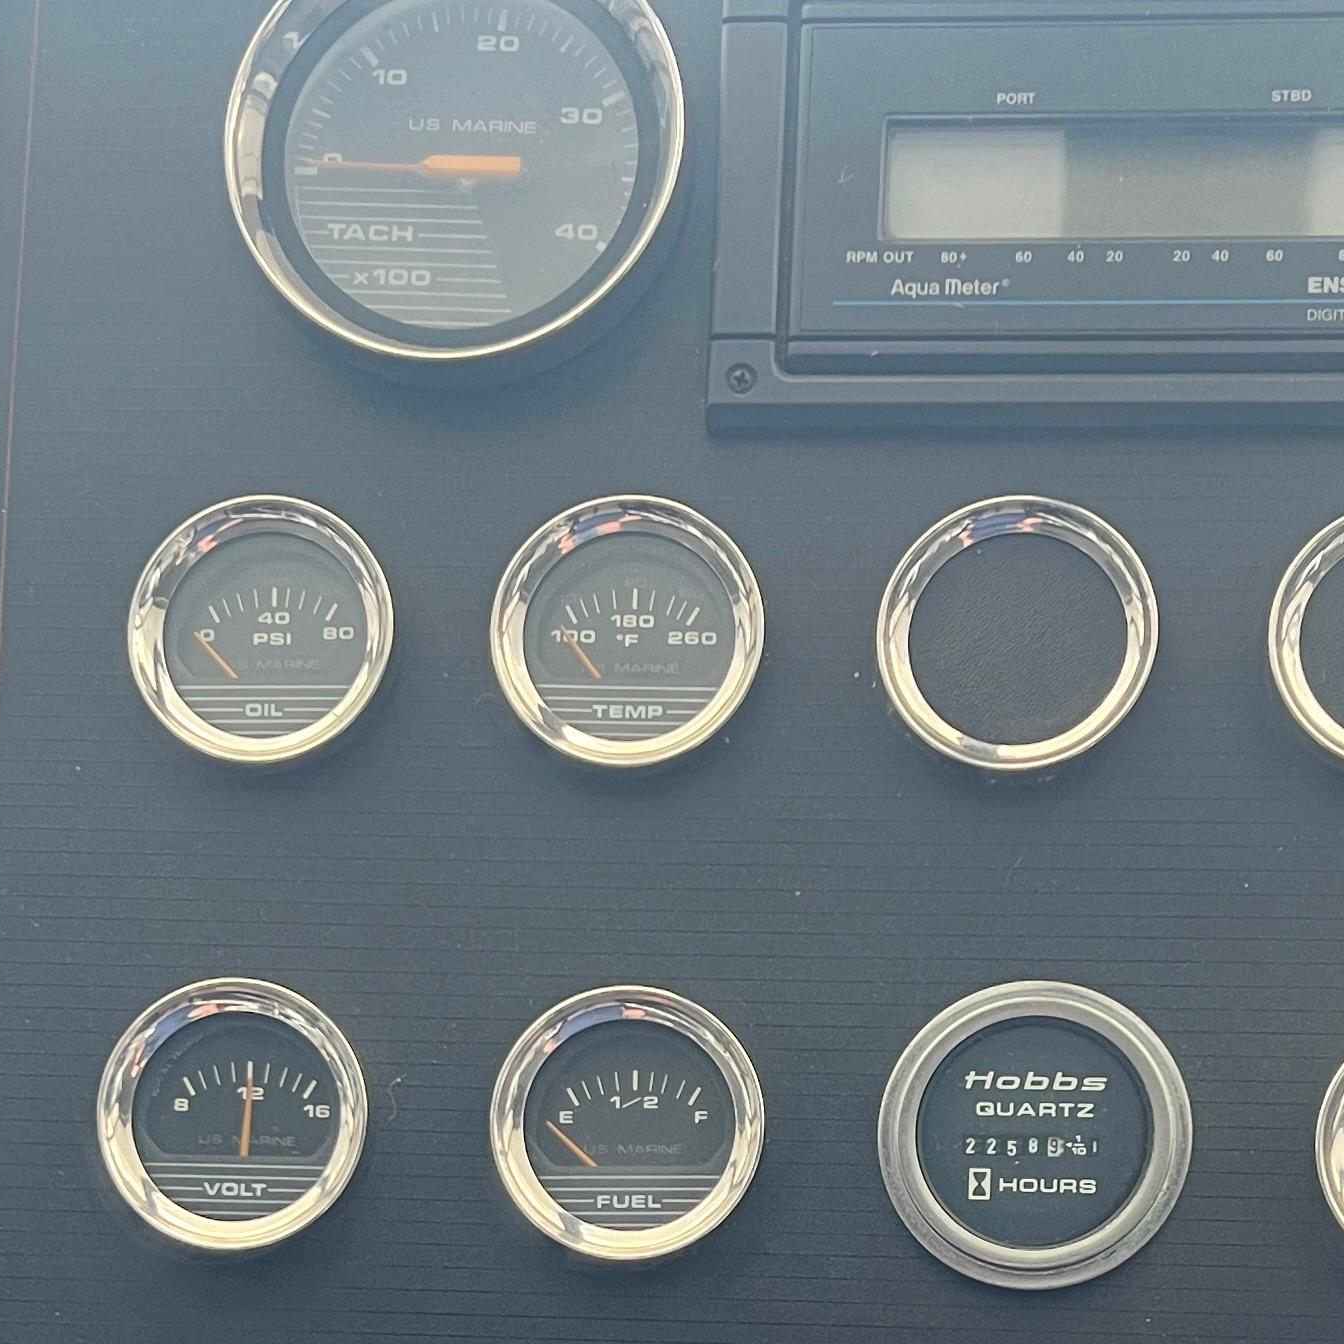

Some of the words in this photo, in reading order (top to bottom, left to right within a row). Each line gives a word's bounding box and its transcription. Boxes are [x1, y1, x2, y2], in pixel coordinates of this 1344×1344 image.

[477, 36, 520, 52] 20
[372, 69, 408, 85] 10
[997, 92, 1036, 105] PORT
[1271, 89, 1312, 102] STBD
[560, 108, 603, 125] 30
[409, 119, 440, 132] US
[453, 119, 537, 135] MARINE
[327, 223, 414, 243] TACH
[555, 224, 598, 241] 40
[846, 251, 879, 264] RPM
[883, 250, 914, 263] OUT
[1015, 250, 1032, 264] 60
[1067, 250, 1085, 263] 40
[1106, 250, 1123, 263] 20
[1173, 250, 1191, 263] 20
[1212, 250, 1229, 263] 40
[1266, 249, 1284, 262] 60
[890, 278, 940, 298] Aqua
[258, 612, 291, 625] 40
[610, 614, 656, 628] 180
[199, 628, 216, 642] 0
[253, 632, 292, 646] PSI
[322, 626, 355, 640] 80
[551, 629, 596, 644] 100
[667, 631, 718, 645] 260
[614, 662, 680, 675] MARINE
[244, 703, 283, 717] OIL
[592, 704, 663, 719] TEMP
[964, 1070, 1108, 1091] Hobbs
[236, 1086, 265, 1101] 12
[173, 1098, 190, 1112] 8
[609, 1095, 659, 1109] 1/2
[975, 1101, 1095, 1118] QUARTZ
[303, 1104, 331, 1119] 16
[558, 1110, 574, 1124] E
[694, 1110, 709, 1124] F
[617, 1143, 684, 1155] MARINE
[203, 1182, 267, 1197] VOLT
[998, 1177, 1097, 1194] HOURS
[596, 1194, 662, 1209] FUEL
